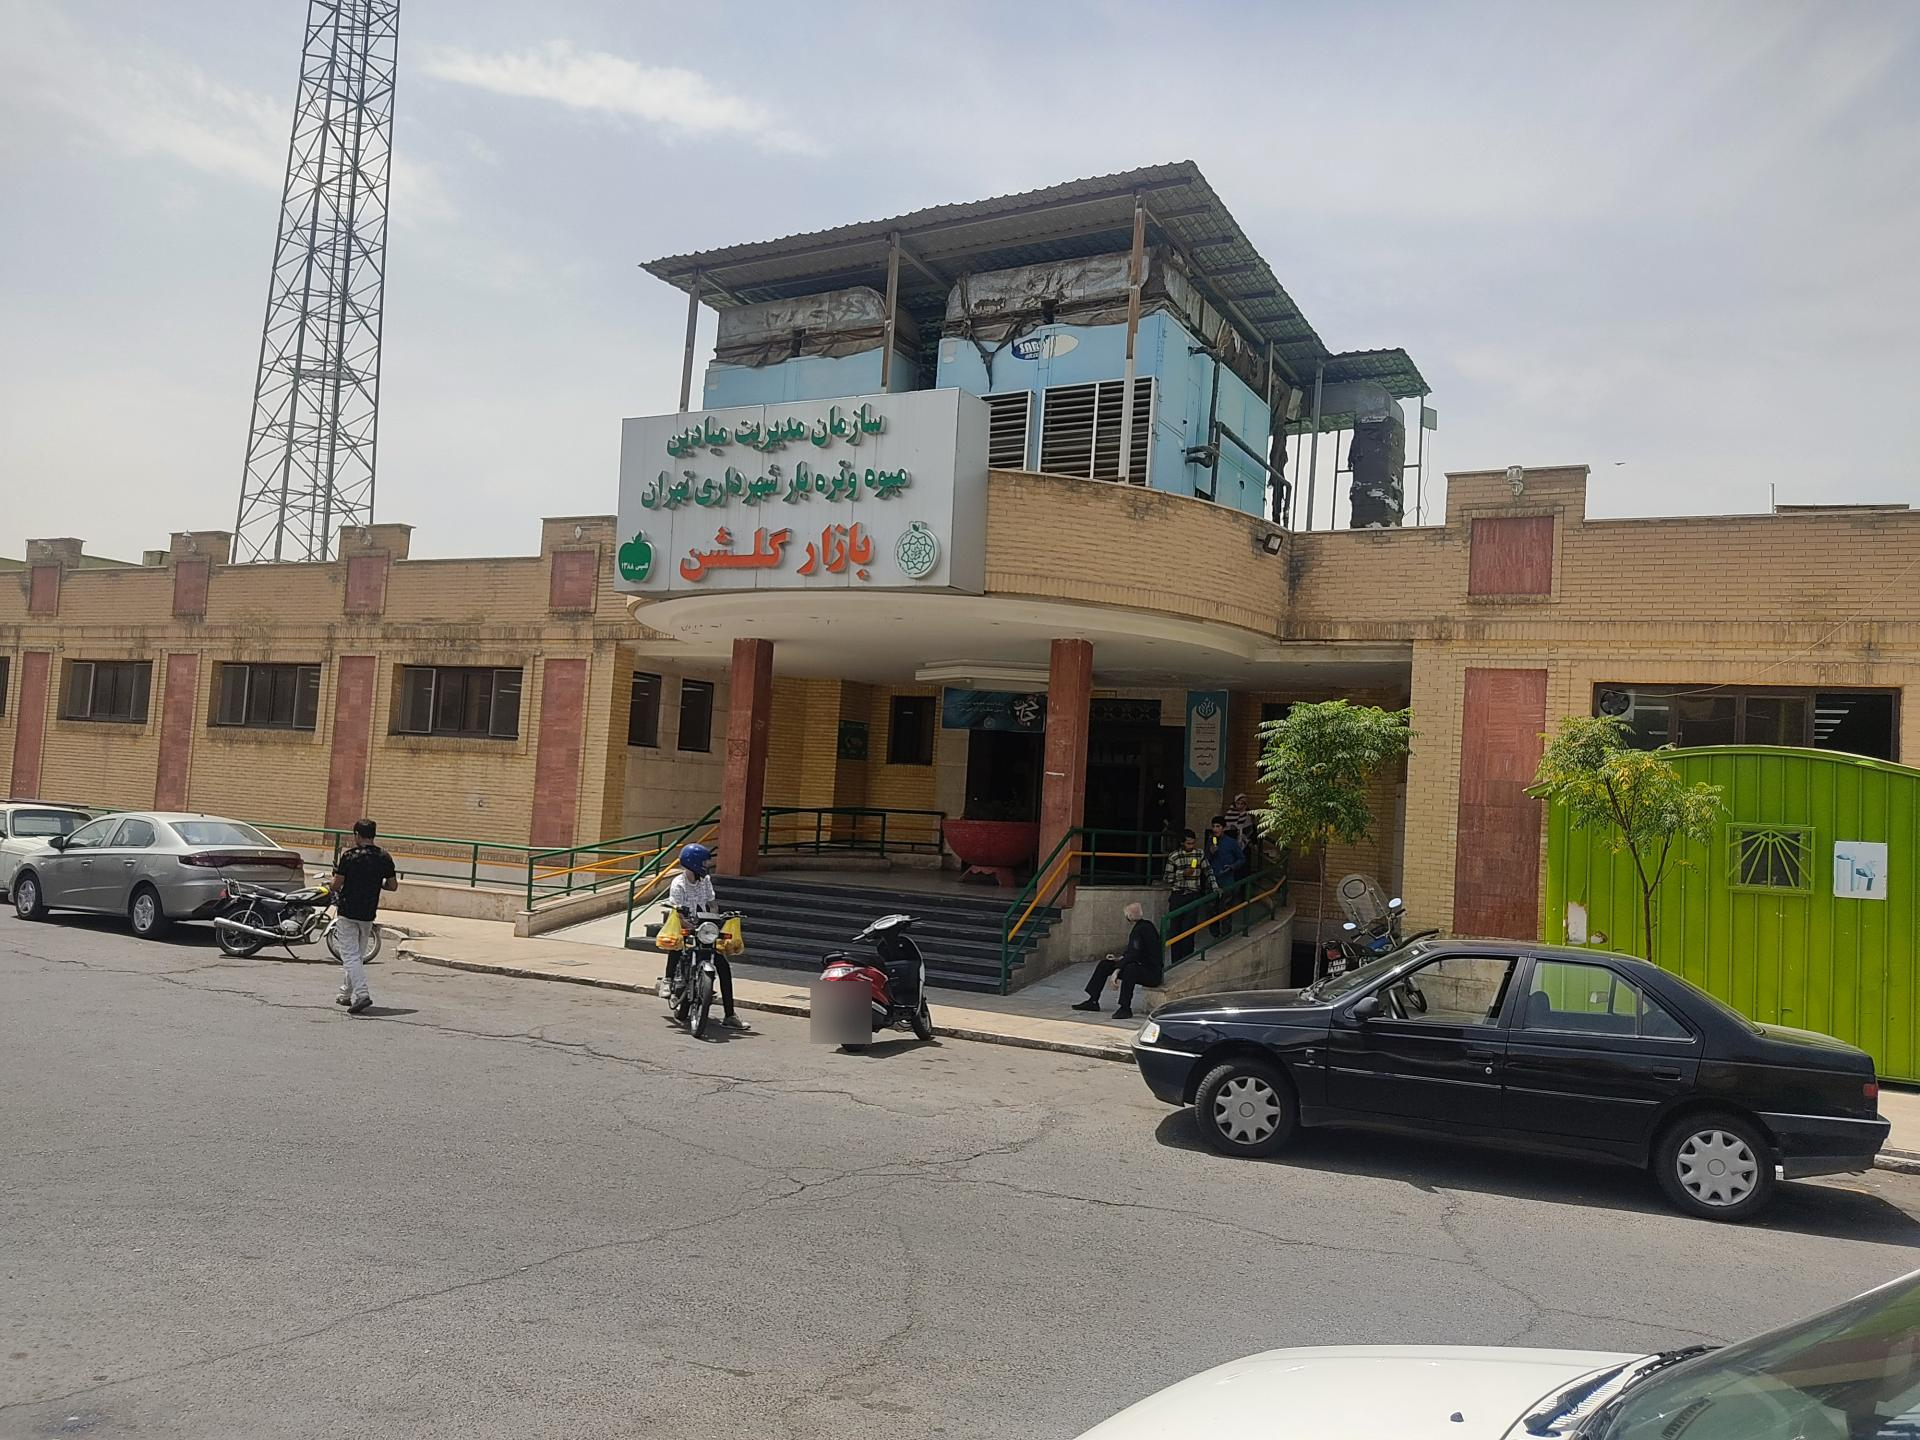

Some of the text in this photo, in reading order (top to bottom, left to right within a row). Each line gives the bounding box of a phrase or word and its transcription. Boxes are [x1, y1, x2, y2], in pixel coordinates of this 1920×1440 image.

[666, 402, 886, 457] سازمان مدیریت میادین
[641, 470, 696, 510] تهران
[695, 463, 782, 508] شهرداری
[864, 466, 910, 499] میوه
[680, 522, 876, 581] بازار گلشن
